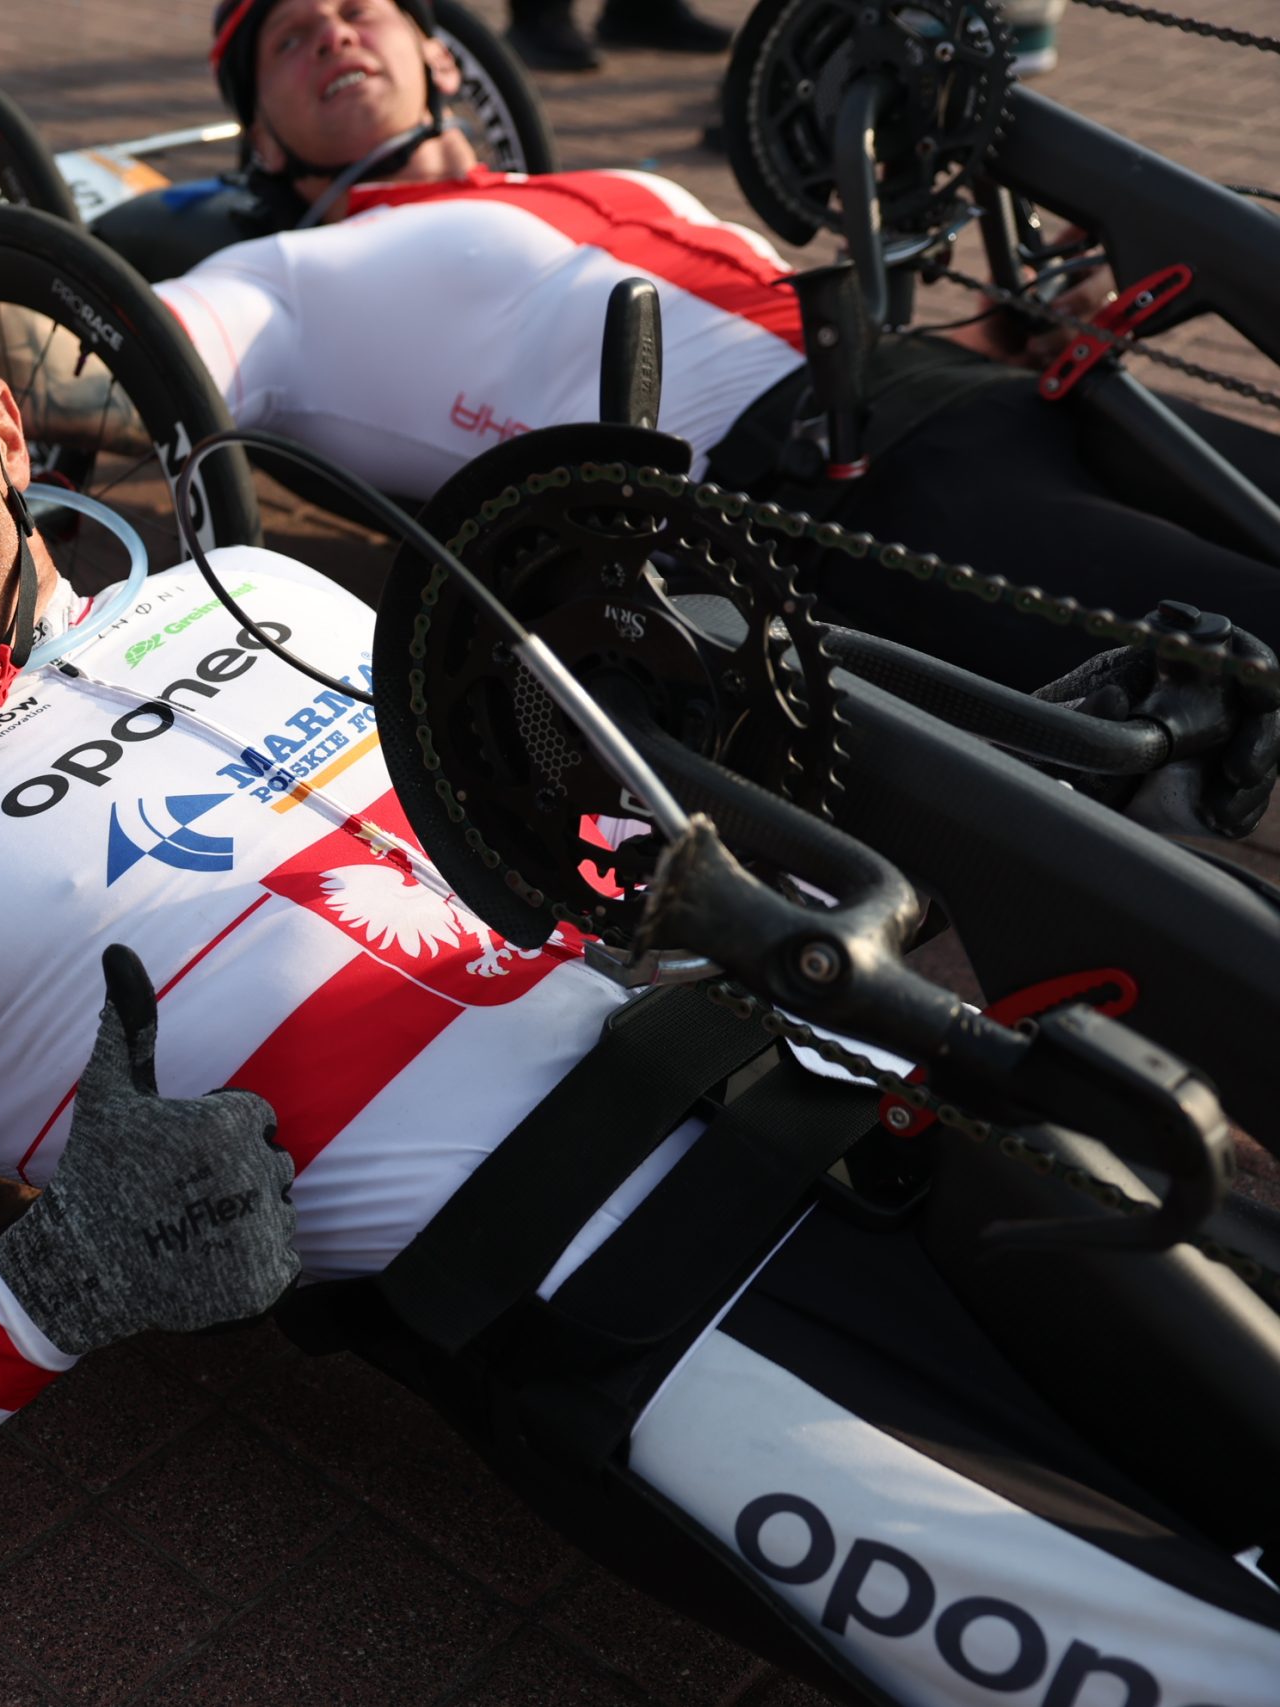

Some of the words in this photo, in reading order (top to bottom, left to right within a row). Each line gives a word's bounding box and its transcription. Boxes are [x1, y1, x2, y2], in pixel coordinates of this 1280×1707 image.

[51, 277, 123, 351] PRORACE
[0, 620, 292, 818] oponeo
[734, 1492, 1220, 1707] opon
